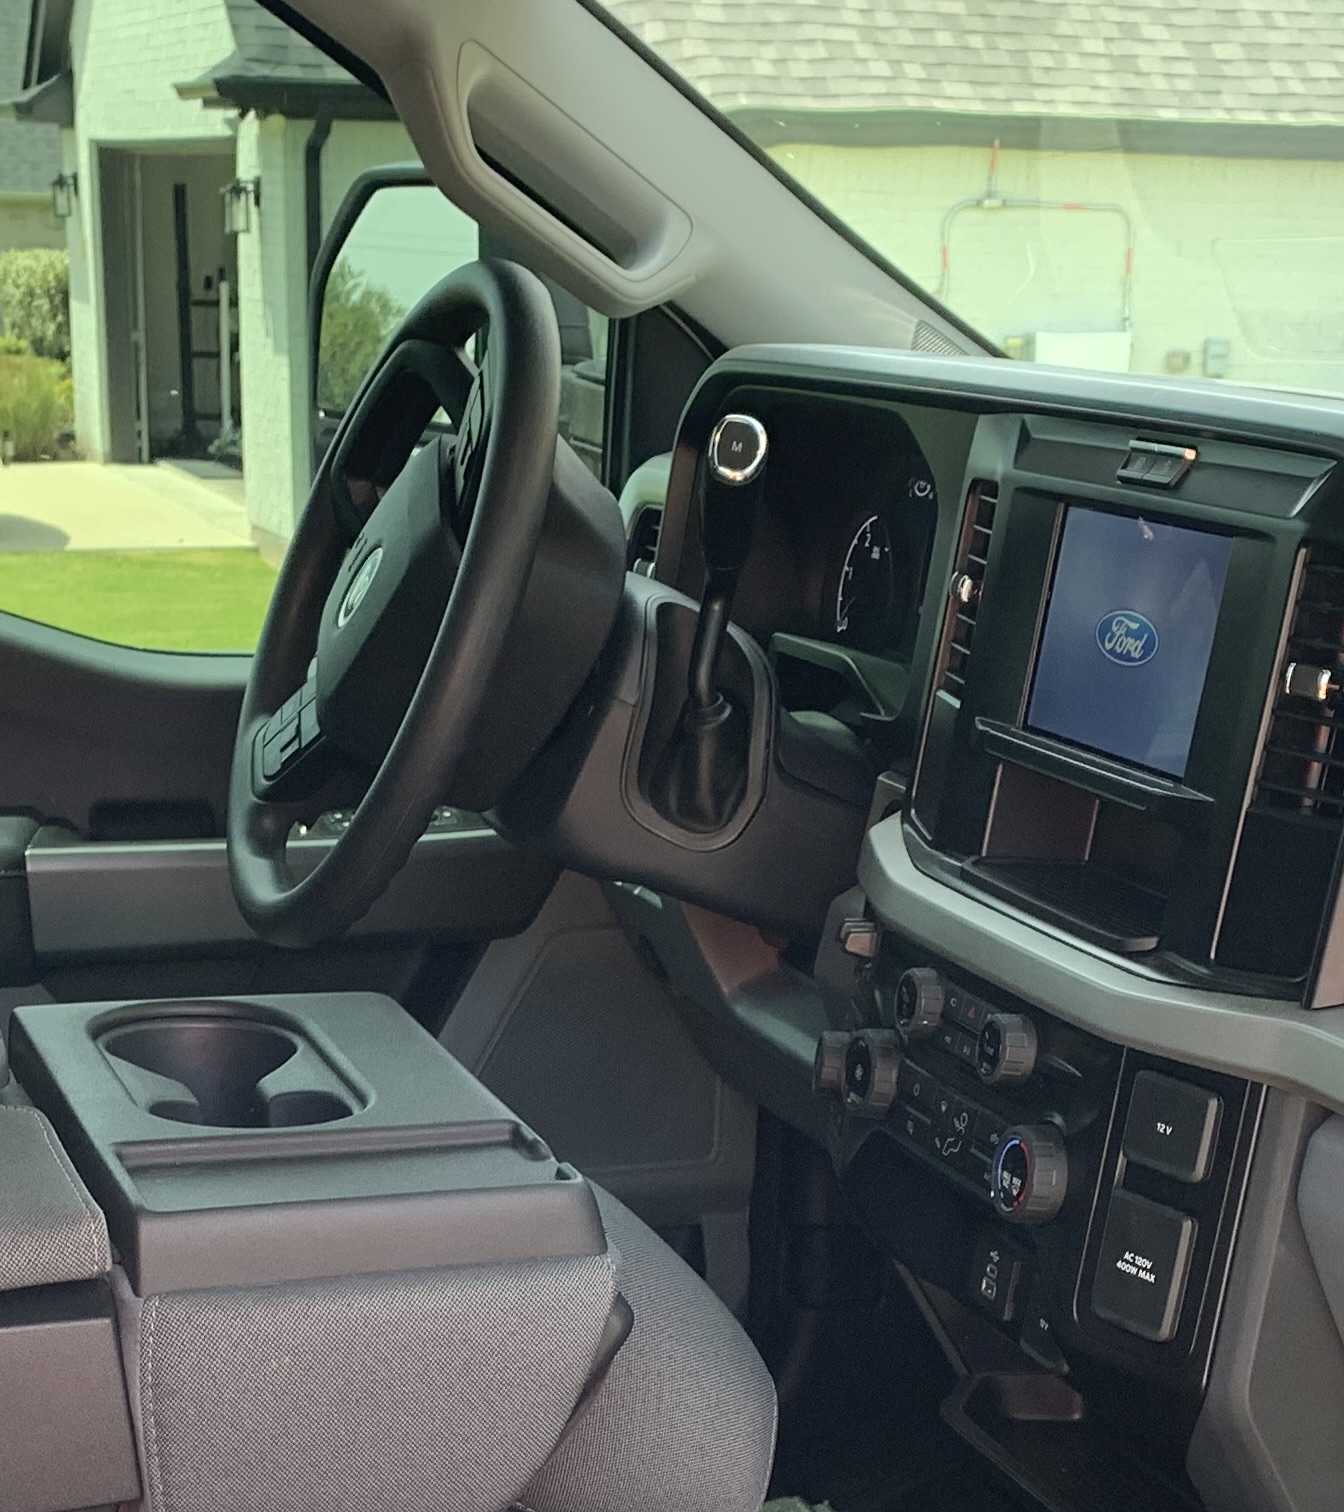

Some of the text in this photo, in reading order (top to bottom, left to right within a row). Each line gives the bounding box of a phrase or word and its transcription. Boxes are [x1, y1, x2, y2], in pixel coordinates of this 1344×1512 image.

[731, 440, 743, 453] M
[1104, 616, 1148, 659] Ford
[1123, 1250, 1153, 1270] AC 120V
[1116, 1259, 1156, 1284] 400W MAX
